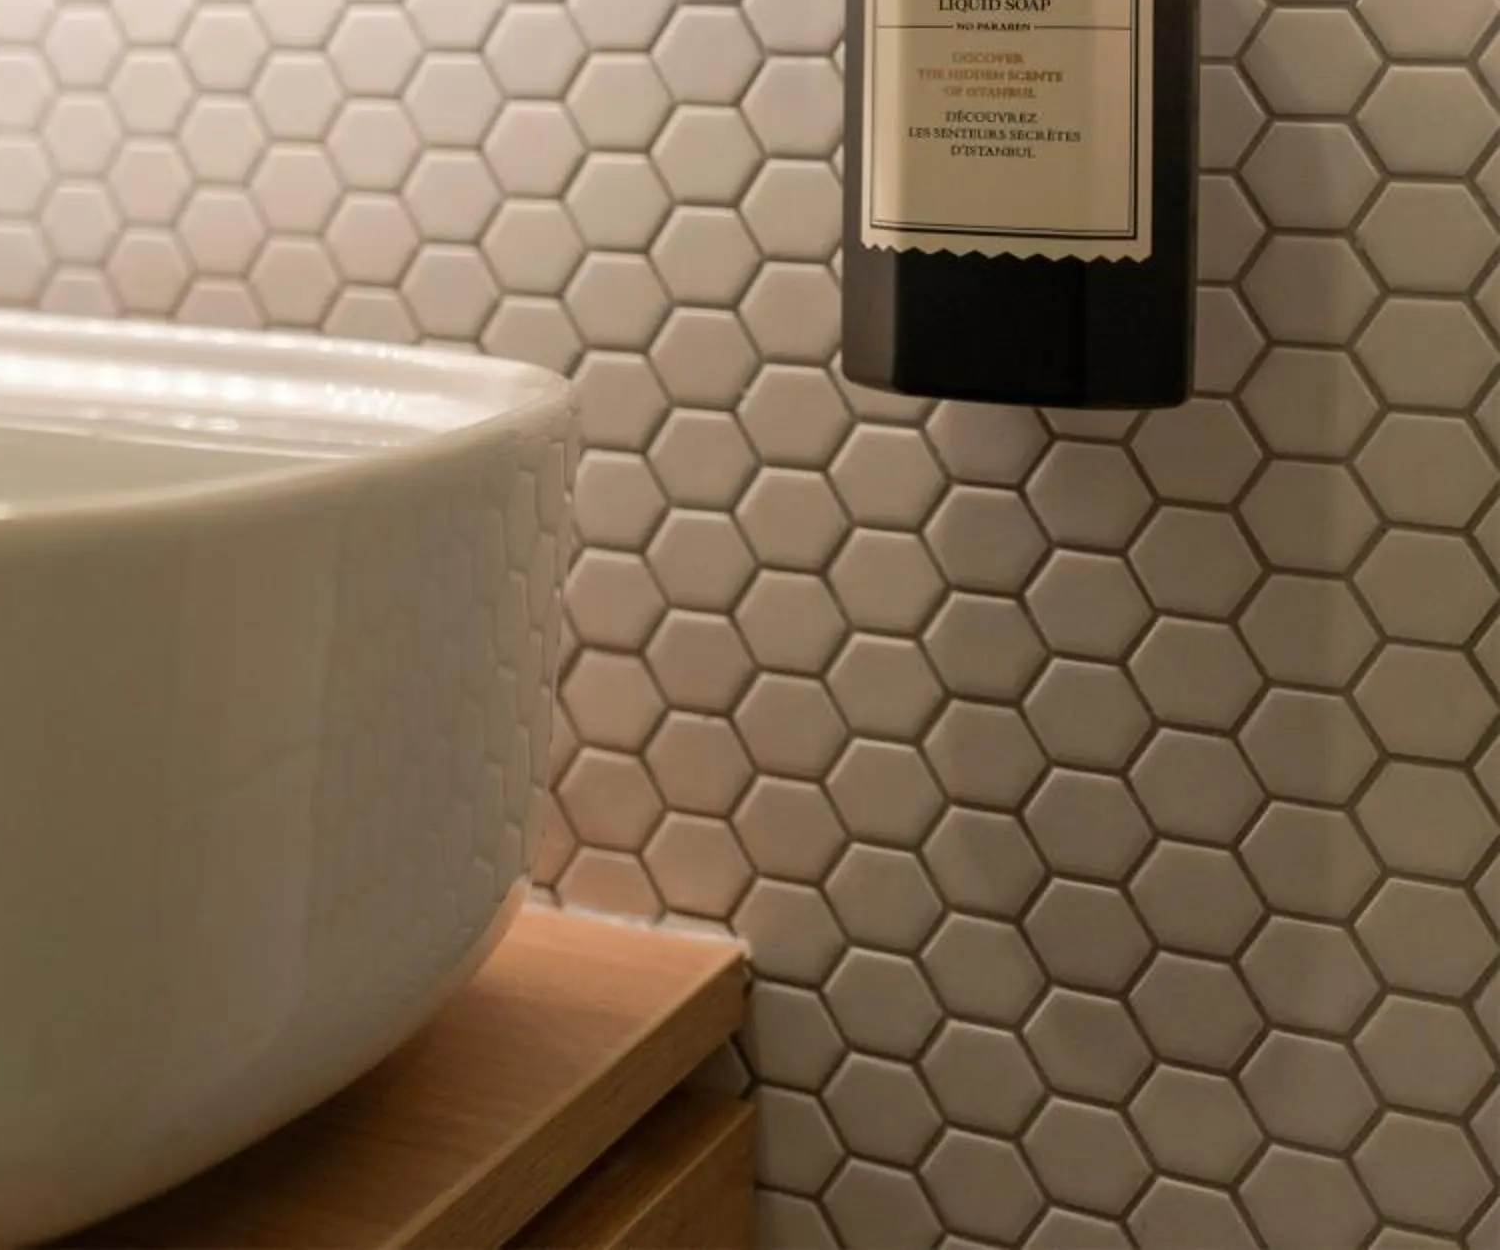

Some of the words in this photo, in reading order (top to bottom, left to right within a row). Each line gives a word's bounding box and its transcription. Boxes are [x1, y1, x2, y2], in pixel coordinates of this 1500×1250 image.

[956, 22, 974, 31] NO
[908, 127, 931, 138] LES
[934, 127, 1006, 140] SENTEURS
